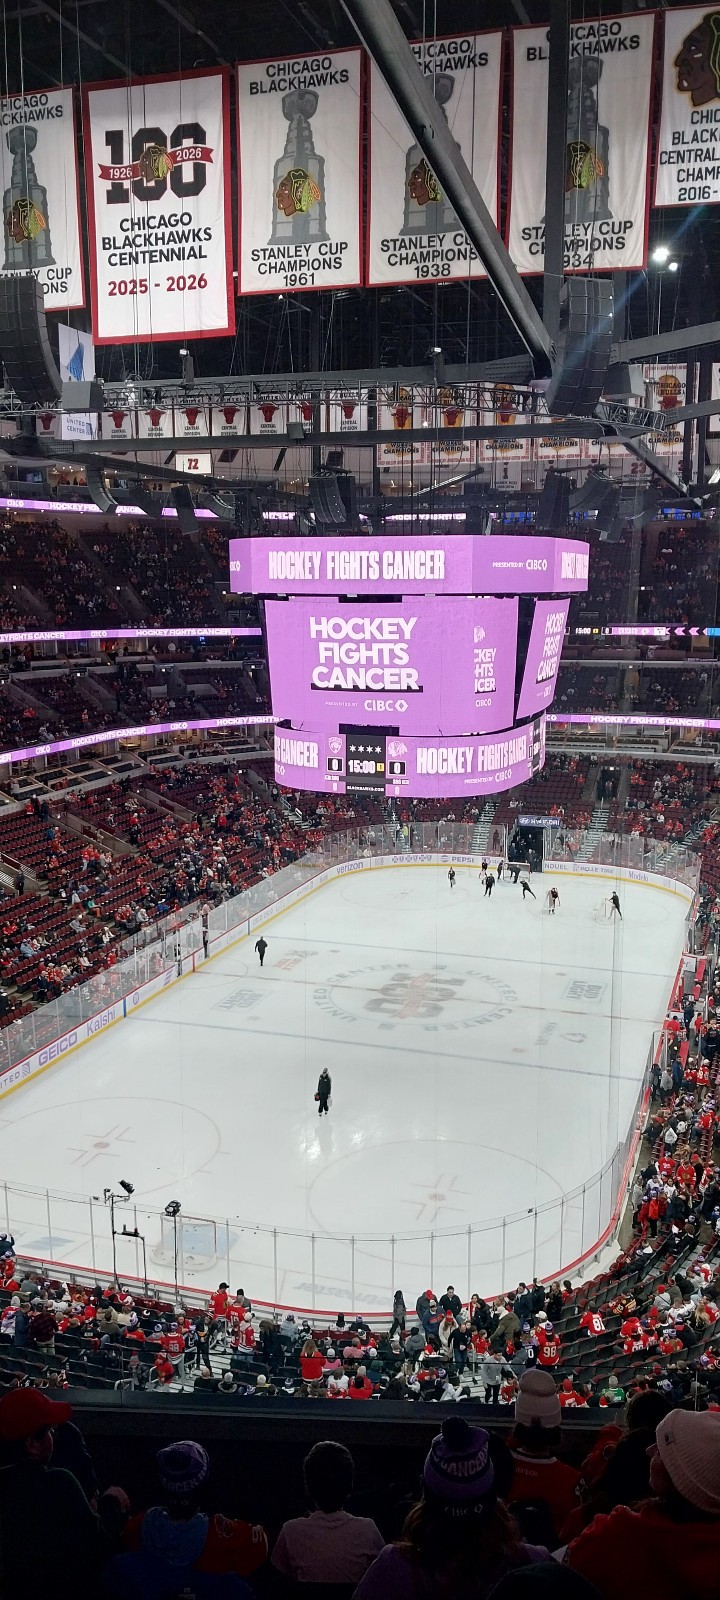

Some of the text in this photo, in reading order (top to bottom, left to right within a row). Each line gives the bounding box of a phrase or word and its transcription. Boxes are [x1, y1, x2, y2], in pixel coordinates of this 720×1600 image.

[412, 39, 471, 60] HICAGO
[526, 34, 641, 61] BLKHAWKS
[266, 57, 332, 78] CHICAGO
[418, 52, 488, 75] KHAWKS
[249, 69, 349, 95] BLACKHAWKS
[0, 94, 49, 112] HICAGO
[0, 105, 63, 126] CKHAWKS
[690, 109, 720, 125] CHIC
[672, 128, 720, 145] BLACK
[105, 122, 207, 204] 100
[175, 148, 202, 161] 2026
[109, 167, 132, 179] 1926
[676, 166, 720, 182] CHAMP
[119, 212, 193, 232] CHICAGO
[521, 220, 634, 241] STALEY CUP
[102, 227, 212, 251] BLACKHAWKS
[380, 232, 471, 252] STANLEY CU
[107, 245, 208, 267] CENTENNIAL
[251, 242, 348, 262] STANLEY CUP
[387, 247, 478, 267] CHAMPIONS
[563, 252, 594, 268] 934
[47, 268, 73, 280] CUP
[257, 257, 343, 275] CHAMPIONS
[414, 263, 451, 278] 1938
[108, 279, 149, 296] 2025
[166, 273, 208, 291] 2026
[283, 273, 315, 287] 1961
[66, 418, 86, 426] UNITED
[66, 425, 86, 434] CENTER
[187, 459, 199, 470] 72
[631, 462, 647, 475] 23
[50, 503, 85, 511] HOCKEY
[268, 549, 445, 580] HOCKEY FIGHTS CANCER
[526, 559, 542, 570] CIBC
[34, 631, 65, 640] CANCER
[197, 628, 231, 636] CANCER
[309, 616, 418, 640] HOCKEY
[575, 627, 591, 635] 15:00
[318, 641, 410, 665] FIGHTS
[312, 665, 420, 690] CANCER
[364, 699, 394, 711] CIBC
[217, 717, 249, 726] HOCKEY
[590, 717, 705, 727] HOCKEY FIGHTS CANCER
[72, 736, 96, 747] HOCKEY
[116, 727, 147, 738] CANCER
[281, 737, 319, 768] CANCER
[416, 746, 474, 774] HOCKEY
[477, 741, 508, 772] FIGHTS
[332, 758, 339, 771] 0
[348, 759, 376, 774] 15:00
[393, 762, 400, 774] 0
[495, 770, 507, 782] CIBC
[336, 860, 364, 875] verizon
[86, 1009, 116, 1037] Kalshi
[38, 1031, 78, 1067] GEICO
[0, 1071, 20, 1089] ITED
[593, 1318, 606, 1332] 81
[543, 1346, 557, 1358] 98
